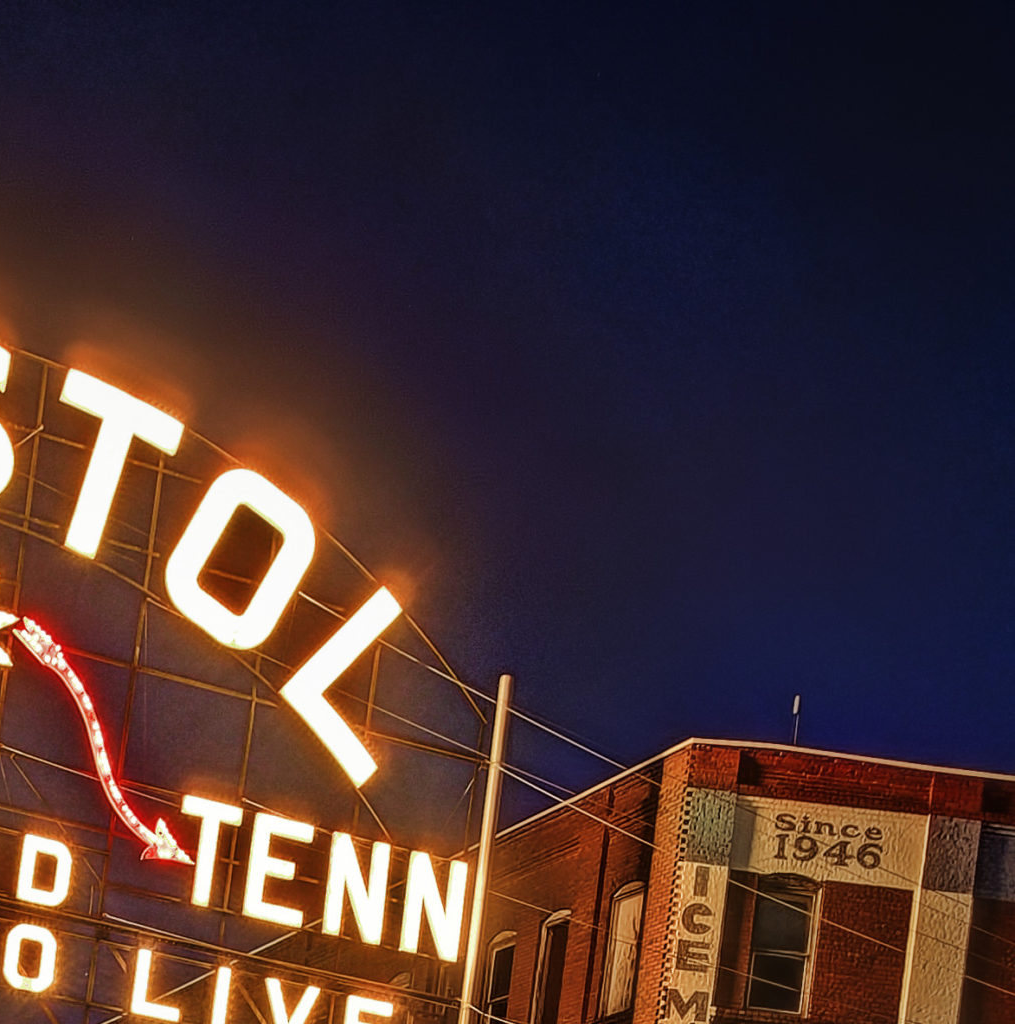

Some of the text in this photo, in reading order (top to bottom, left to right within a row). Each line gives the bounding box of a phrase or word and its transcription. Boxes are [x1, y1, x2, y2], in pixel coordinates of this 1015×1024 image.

[773, 833, 884, 869] 1946
[774, 813, 884, 841] Since
[181, 794, 469, 962] TENN
[677, 865, 714, 974] ICE
